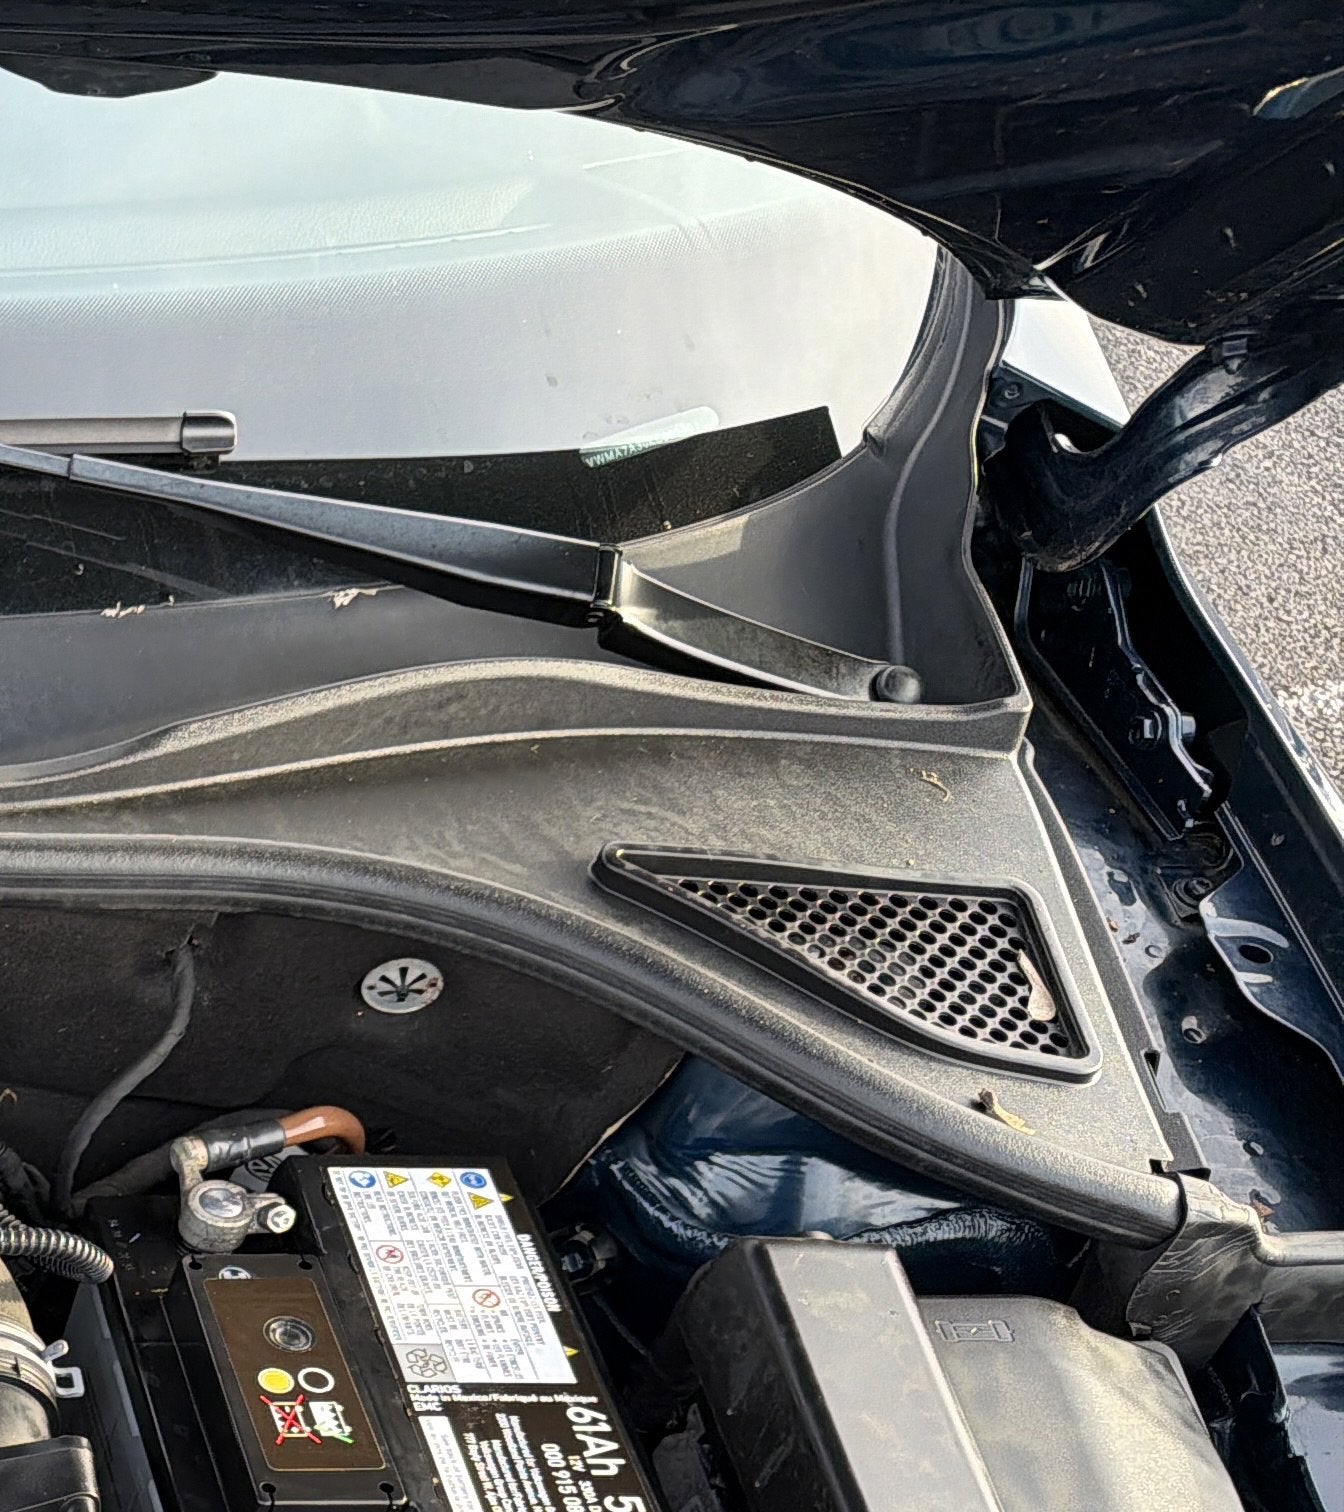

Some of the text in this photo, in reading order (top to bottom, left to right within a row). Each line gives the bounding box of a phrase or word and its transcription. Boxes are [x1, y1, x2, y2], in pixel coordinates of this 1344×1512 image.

[518, 1233, 561, 1313] DANGER/POISON
[406, 1384, 461, 1394] CLARIOS
[538, 1443, 567, 1467] 000
[565, 1405, 626, 1477] 61Ah
[549, 1470, 579, 1494] 915
[566, 1455, 586, 1471] 12V
[576, 1480, 600, 1503] 330A
